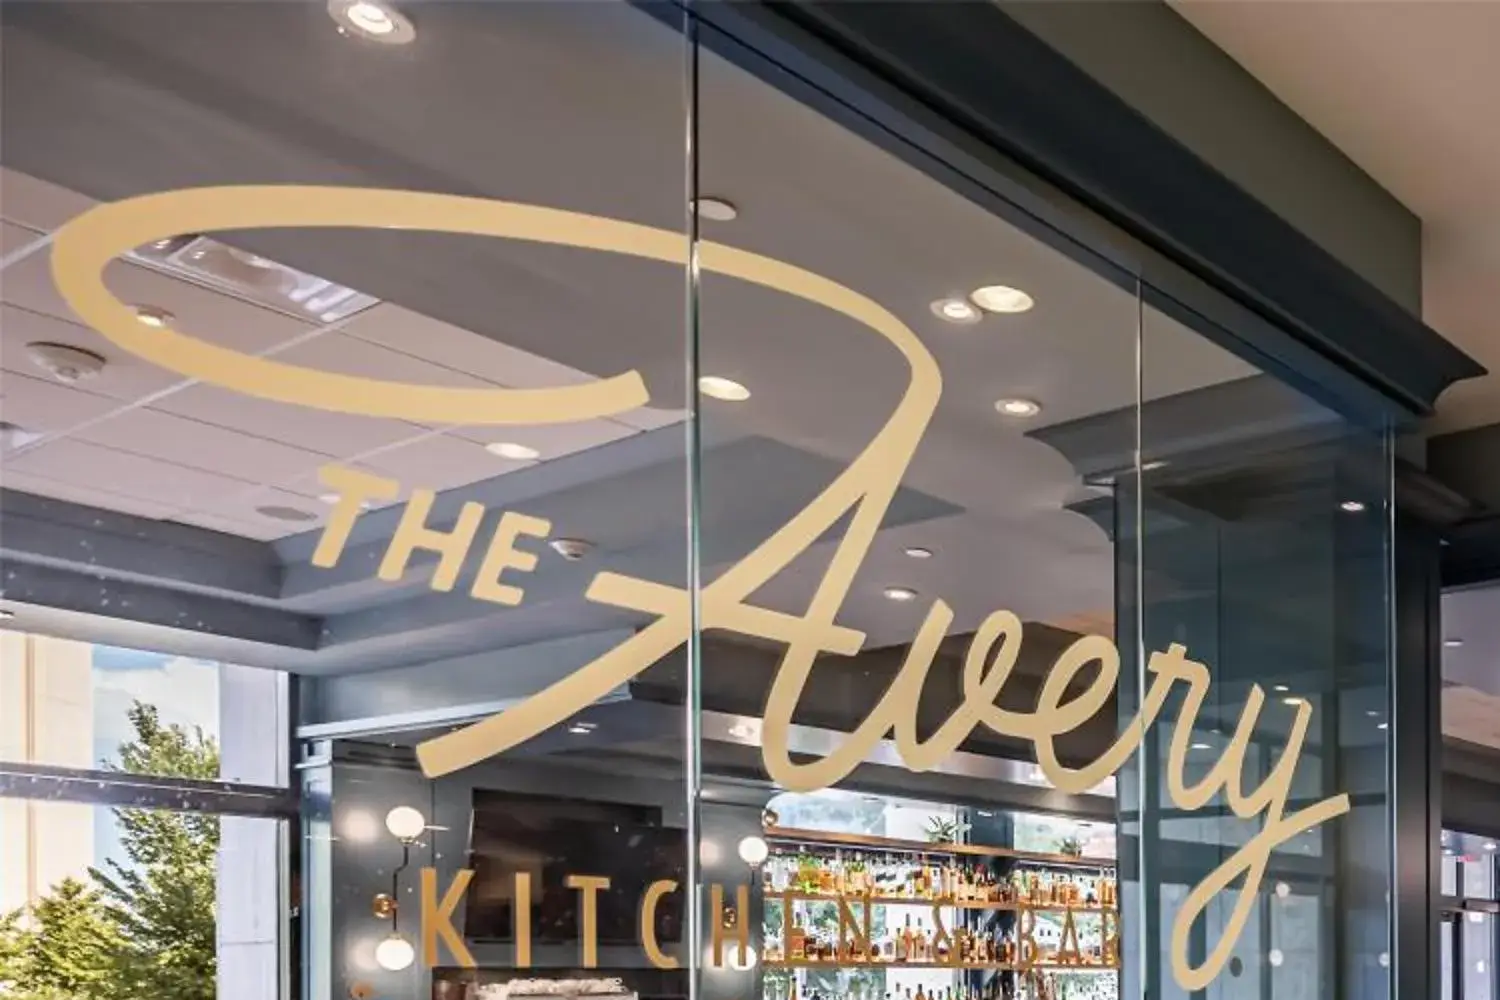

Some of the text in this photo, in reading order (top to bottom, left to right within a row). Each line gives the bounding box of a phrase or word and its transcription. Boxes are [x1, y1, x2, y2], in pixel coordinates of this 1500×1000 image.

[49, 184, 1350, 991] Avery
[310, 463, 553, 606] THE
[419, 866, 1122, 970] KITCHEN & BAR
